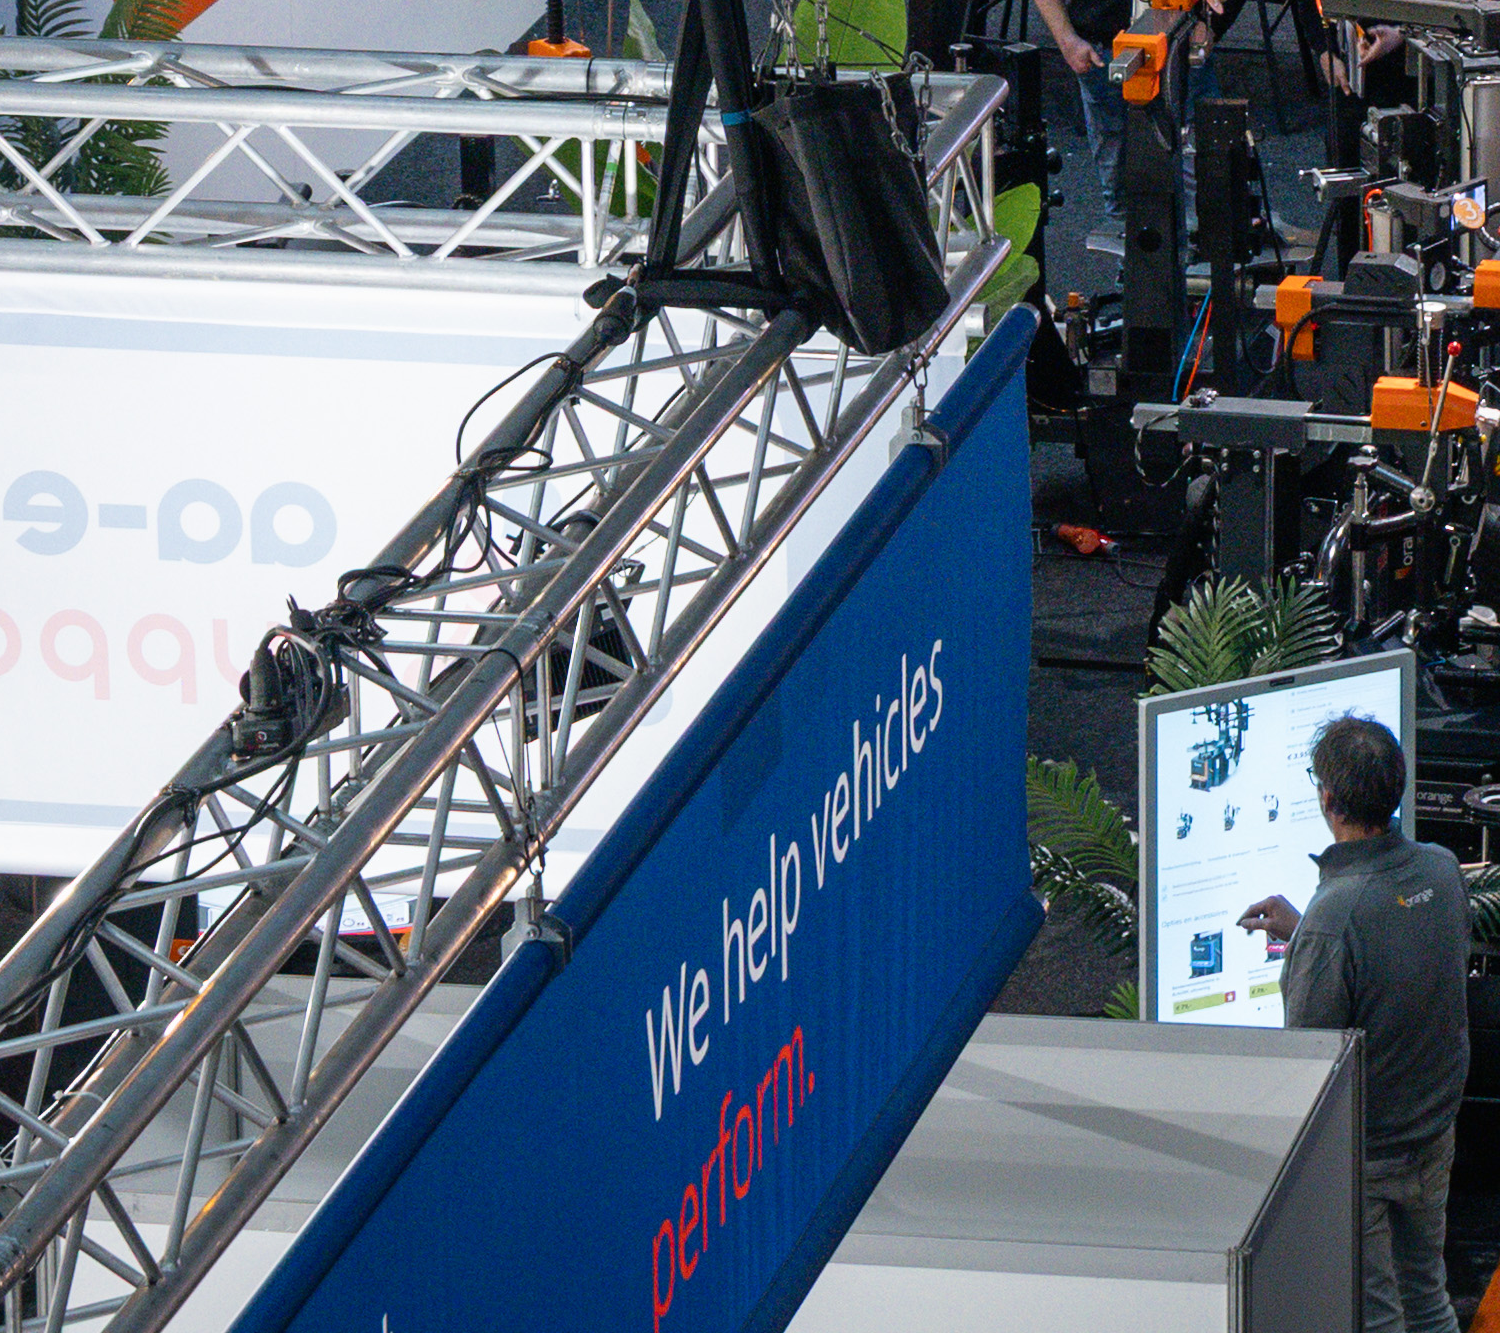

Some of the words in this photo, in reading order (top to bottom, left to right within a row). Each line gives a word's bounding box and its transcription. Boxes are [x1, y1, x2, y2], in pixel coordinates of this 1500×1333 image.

[646, 965, 709, 1120] We
[723, 836, 800, 1023] help
[812, 638, 943, 891] vehicles
[651, 1026, 816, 1333] perform.
